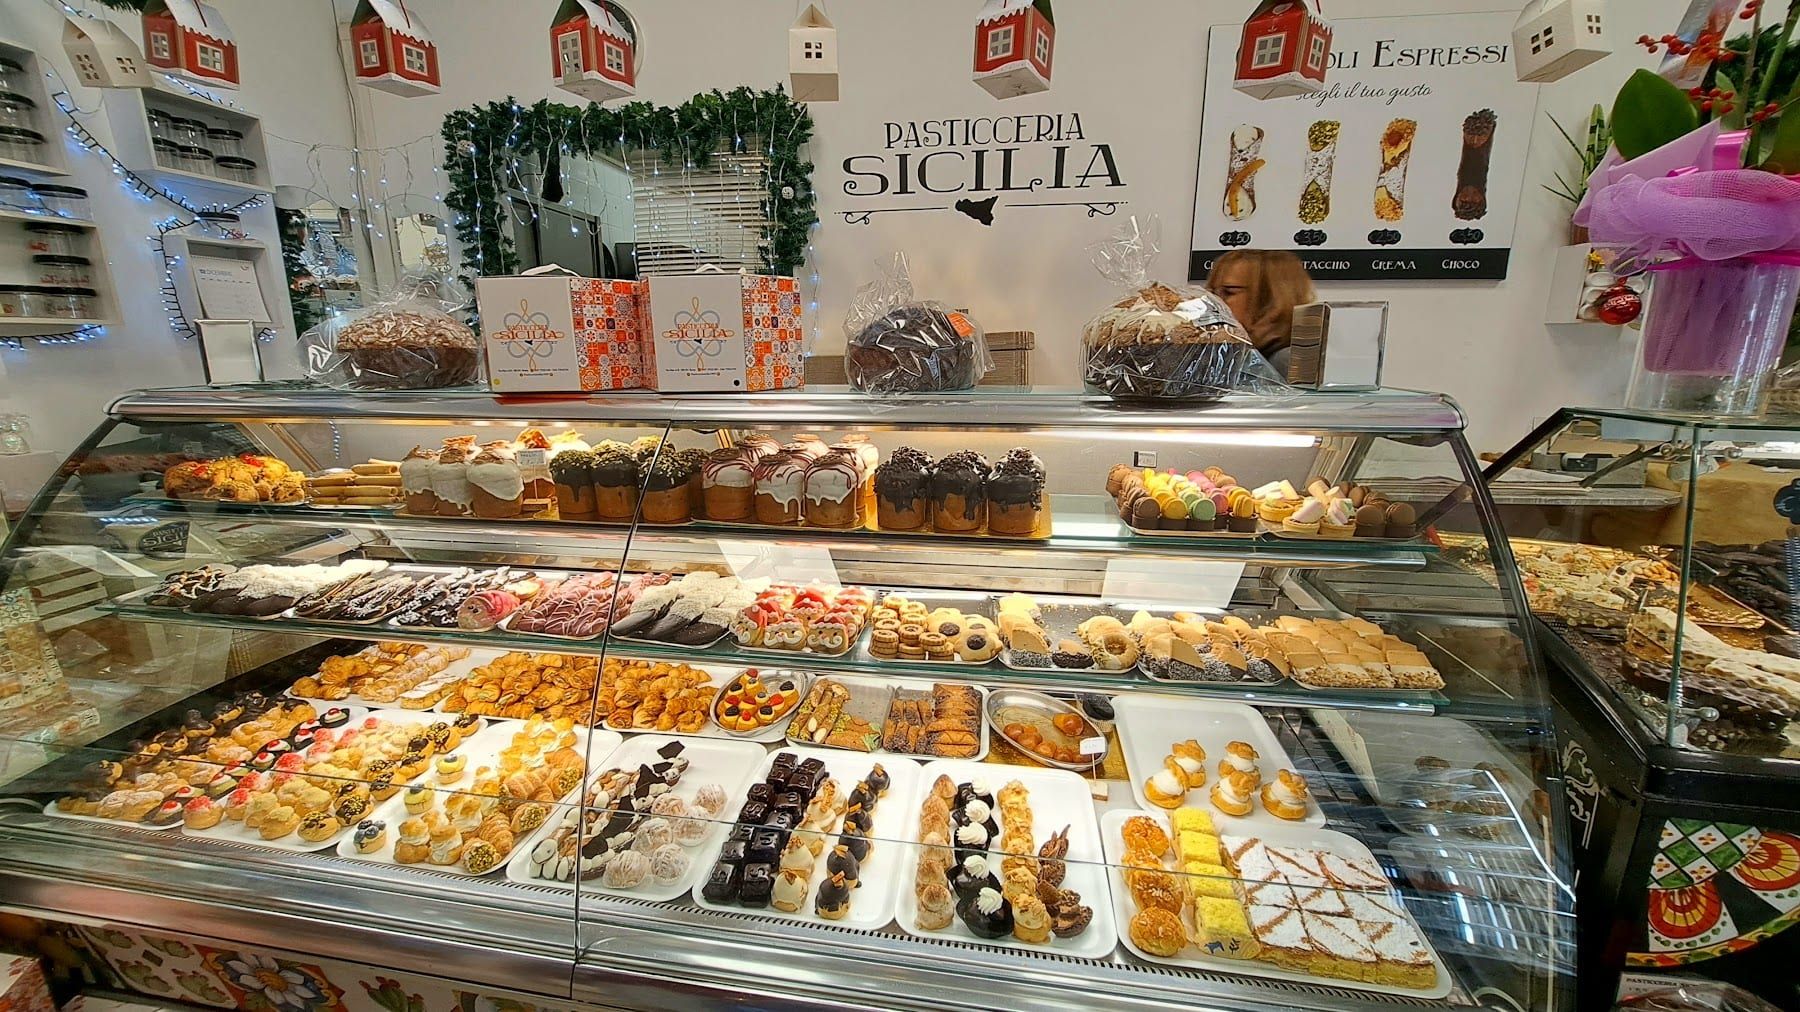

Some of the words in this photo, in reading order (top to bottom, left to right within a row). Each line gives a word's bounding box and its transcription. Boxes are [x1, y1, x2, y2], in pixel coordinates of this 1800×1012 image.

[1344, 82, 1361, 98] il
[1359, 85, 1385, 98] tuo
[1385, 83, 1433, 105] gusto
[883, 112, 1086, 149] PASTICCERIA
[842, 143, 1127, 196] SICILIA
[1303, 260, 1350, 270] TACCHIO
[1371, 259, 1417, 271] CREMA
[1441, 258, 1480, 270] CHOCO
[498, 329, 559, 340] SICILIA
[668, 328, 728, 339] SICILIA
[142, 531, 188, 546] SICIL
